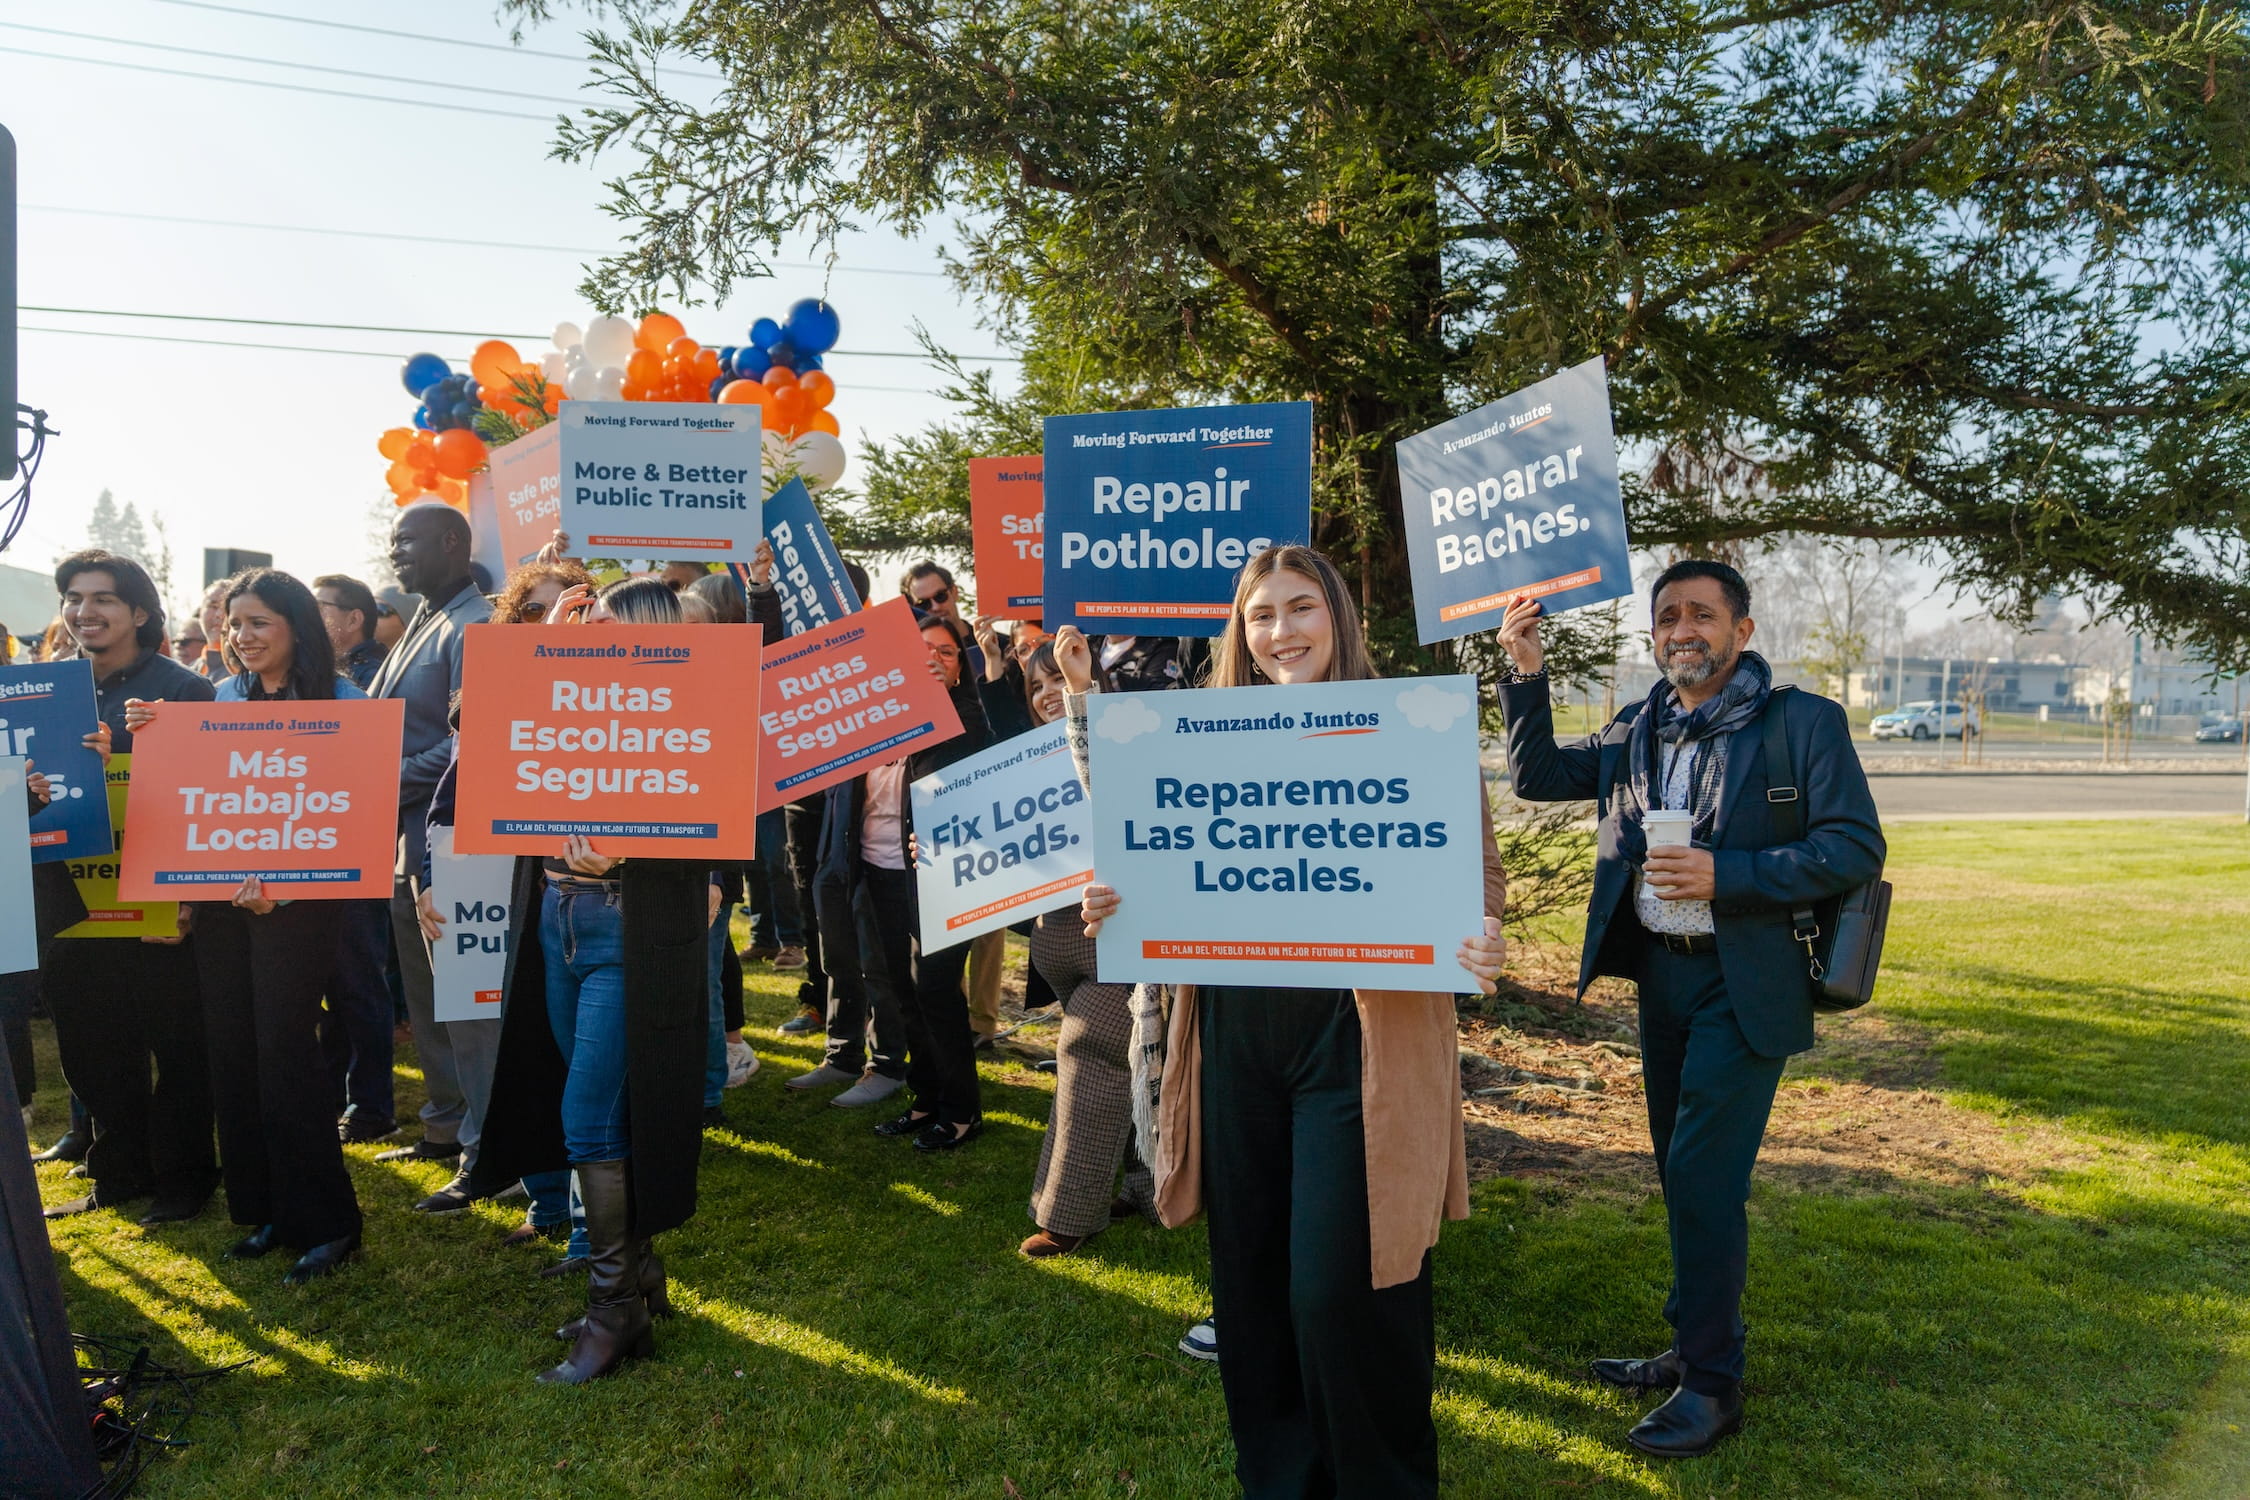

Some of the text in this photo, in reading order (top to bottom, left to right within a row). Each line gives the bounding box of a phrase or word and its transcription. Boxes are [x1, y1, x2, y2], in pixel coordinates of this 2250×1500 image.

[584, 415, 735, 430] Moving Forward Together
[1073, 425, 1273, 449] Moving Forward Together
[1443, 402, 1552, 455] Avanzando Juntos
[575, 461, 747, 484] More & Better
[997, 471, 1044, 482] Moving
[1430, 443, 1583, 527] Reparar
[508, 484, 537, 508] Safe
[516, 494, 560, 526] To Sch
[576, 487, 747, 510] Public Transit
[1093, 467, 1250, 523] Repair
[1001, 512, 1044, 535] Saf
[1436, 503, 1590, 574] Baches.
[1013, 539, 1044, 560] To
[805, 522, 852, 616] Avanzando Juntos
[1085, 605, 1230, 615] THE PEOPLE'S PLAN FOR A BETTER TRANSPORTATION
[1450, 609, 1456, 617] EL
[1457, 605, 1468, 615] PLAN
[1468, 603, 1477, 612] DEL
[1477, 597, 1495, 610] PUEBLO
[1495, 594, 1507, 606] PARA
[1531, 583, 1550, 594] FUTURO
[1558, 573, 1589, 588] TRANSPORTE
[534, 644, 691, 659] Avanzando Juntos
[824, 627, 865, 647] Juntos
[0, 681, 55, 698] gether
[778, 654, 868, 700] Rutas
[552, 680, 672, 712] Rutas
[760, 667, 906, 736] Escolares
[200, 719, 341, 732] Avanzando Juntos
[510, 719, 711, 753] Escolares
[776, 696, 910, 759] Seguras.
[1175, 710, 1380, 734] Avanzando Juntos
[228, 748, 307, 778] Más
[785, 779, 793, 787] EL
[793, 774, 806, 784] PLAN
[806, 770, 816, 779] DEL
[816, 763, 833, 775] PUEBLO
[834, 758, 847, 768] PARA
[847, 755, 855, 763] UN
[854, 748, 870, 760] MEJOR
[870, 741, 888, 753] FUTURO
[895, 727, 924, 743] TRANSPORTE
[933, 735, 1069, 799] Moving Forward Togeth
[516, 760, 700, 801] Seguras.
[1155, 777, 1409, 815] Reparemos
[178, 783, 351, 820] Trabajos
[506, 823, 704, 835] EL PLAN DEL PUEBLO PARA UN MEJOR FUTURO DE TRANSPORTE
[932, 779, 1084, 857] Fix Loca
[1124, 817, 1448, 851] Las Carreteras
[186, 821, 337, 851] Locales
[953, 822, 1080, 888] Roads.
[177, 873, 193, 881] PLAN
[194, 873, 205, 881] DEL
[206, 873, 229, 881] PUEBLO
[277, 872, 300, 880] FUTURO
[1194, 858, 1373, 893] Locales.
[455, 901, 511, 924] Mo
[954, 918, 963, 926] THE
[983, 905, 995, 915] PLAN
[995, 902, 1004, 911] FOR
[1009, 894, 1027, 906] BETTER
[1027, 881, 1067, 900] TRANSPORTATION
[1067, 875, 1087, 886] FUTURE
[1160, 945, 1415, 960] EL PLAN DEL PUEBLO PARA UN MEJOR FUTURO DE TRANSPORTE
